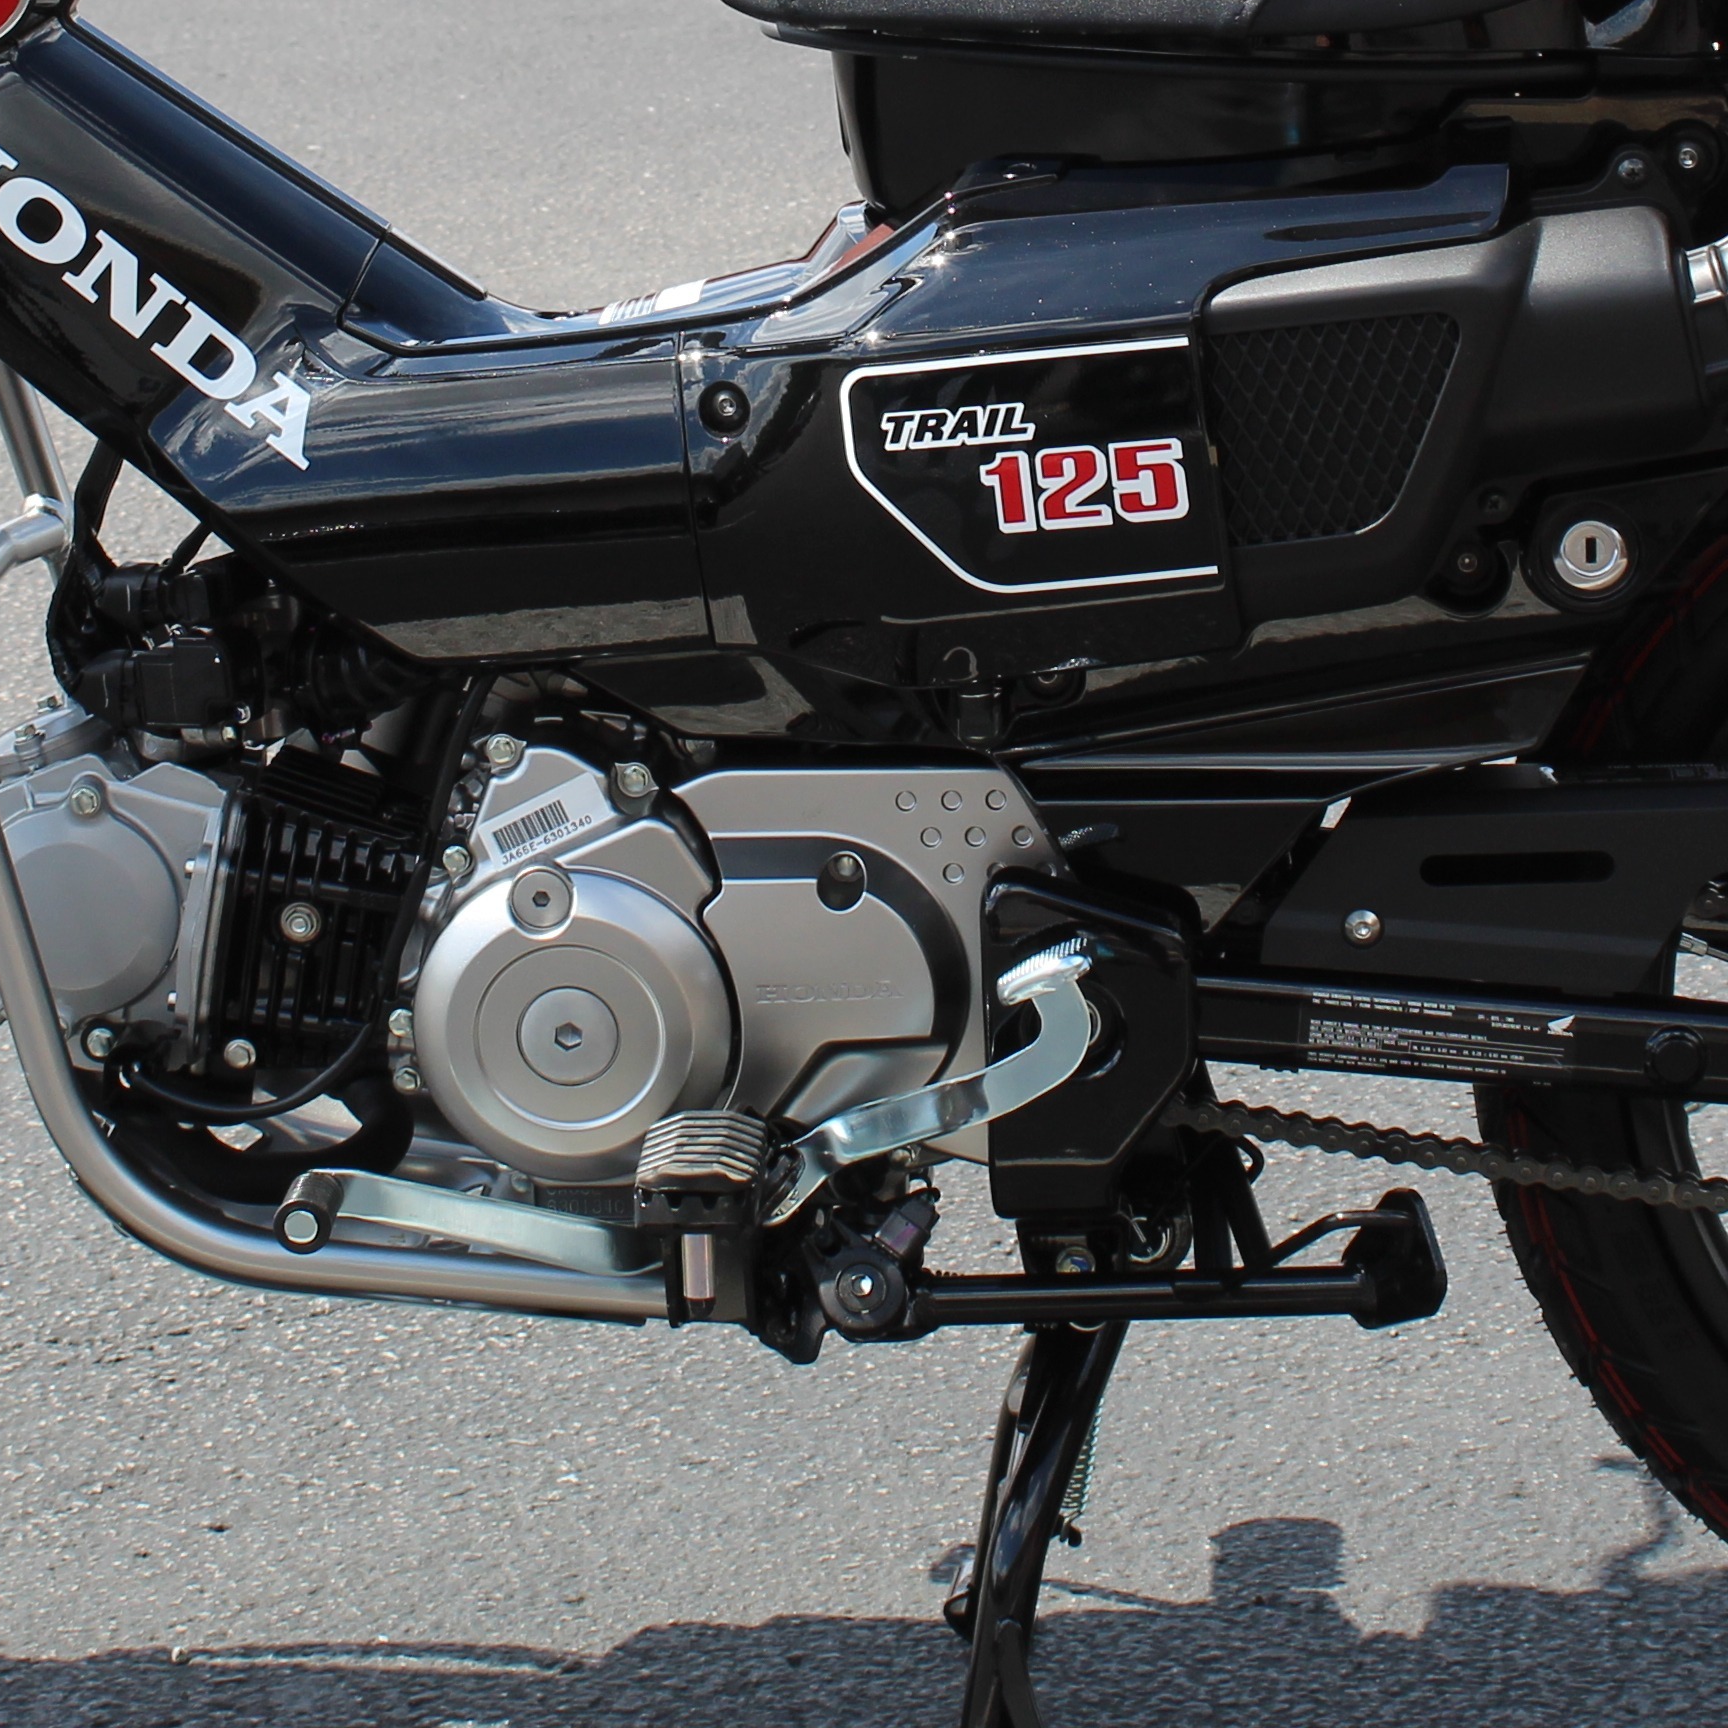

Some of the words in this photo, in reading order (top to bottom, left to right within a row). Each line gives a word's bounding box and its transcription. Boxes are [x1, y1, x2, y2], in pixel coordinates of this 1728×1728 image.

[880, 403, 1035, 451] TRAIL
[980, 438, 1189, 534] 125
[755, 978, 905, 1005] HONDA
